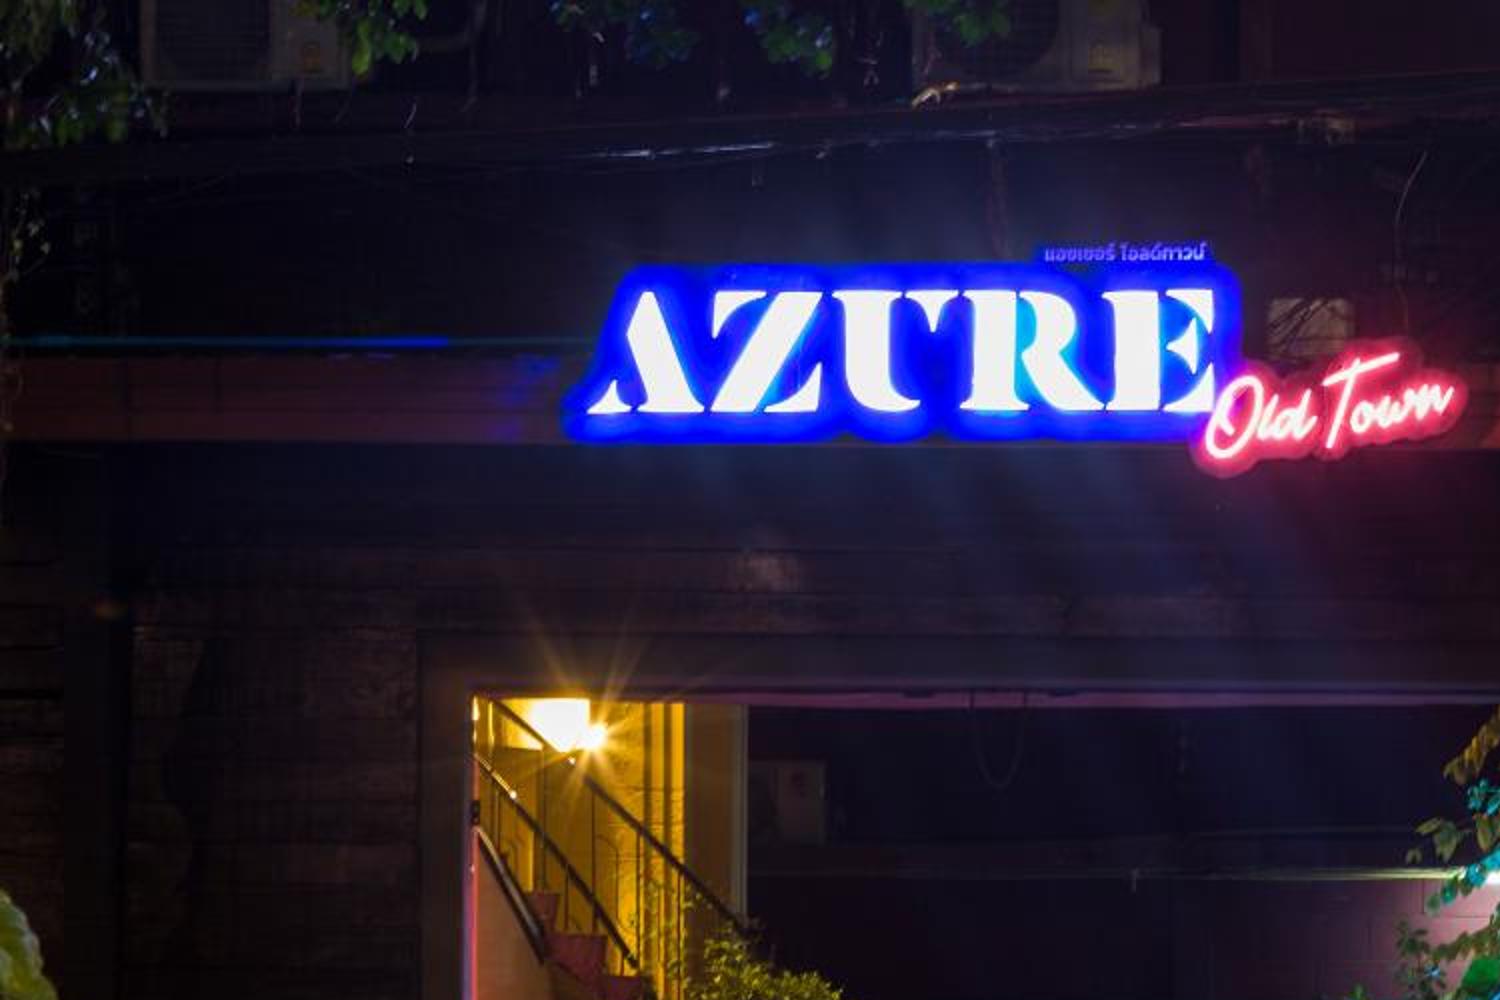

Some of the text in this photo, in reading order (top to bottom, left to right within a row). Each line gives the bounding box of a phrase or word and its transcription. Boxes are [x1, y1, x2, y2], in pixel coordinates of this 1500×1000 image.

[587, 289, 1215, 414] AZURE
[1205, 352, 1454, 459] Old Town
